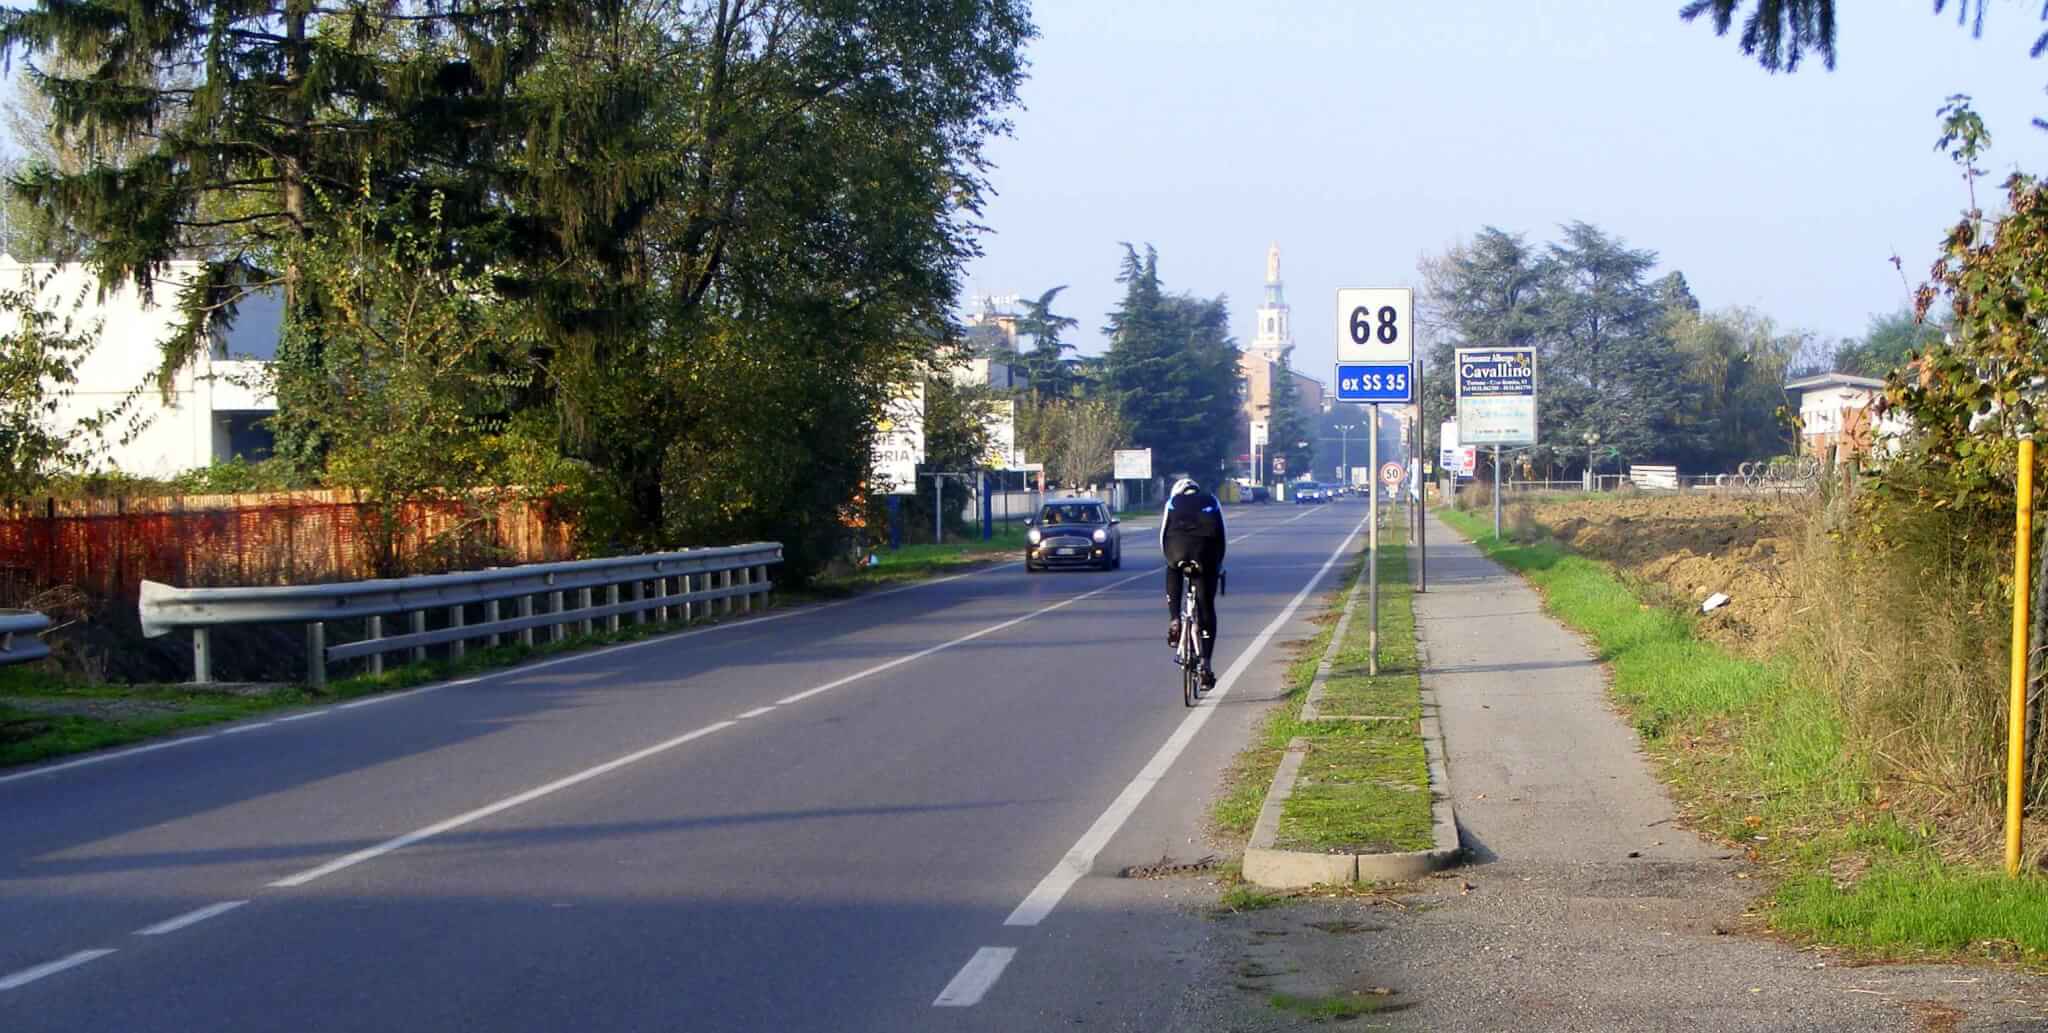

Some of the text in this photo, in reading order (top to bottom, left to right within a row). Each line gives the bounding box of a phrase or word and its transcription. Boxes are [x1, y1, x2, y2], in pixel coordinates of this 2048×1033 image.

[1350, 306, 1398, 344] 68
[1461, 363, 1532, 378] Cavallino
[1342, 374, 1406, 392] ex SS 35
[1386, 468, 1399, 480] 50
